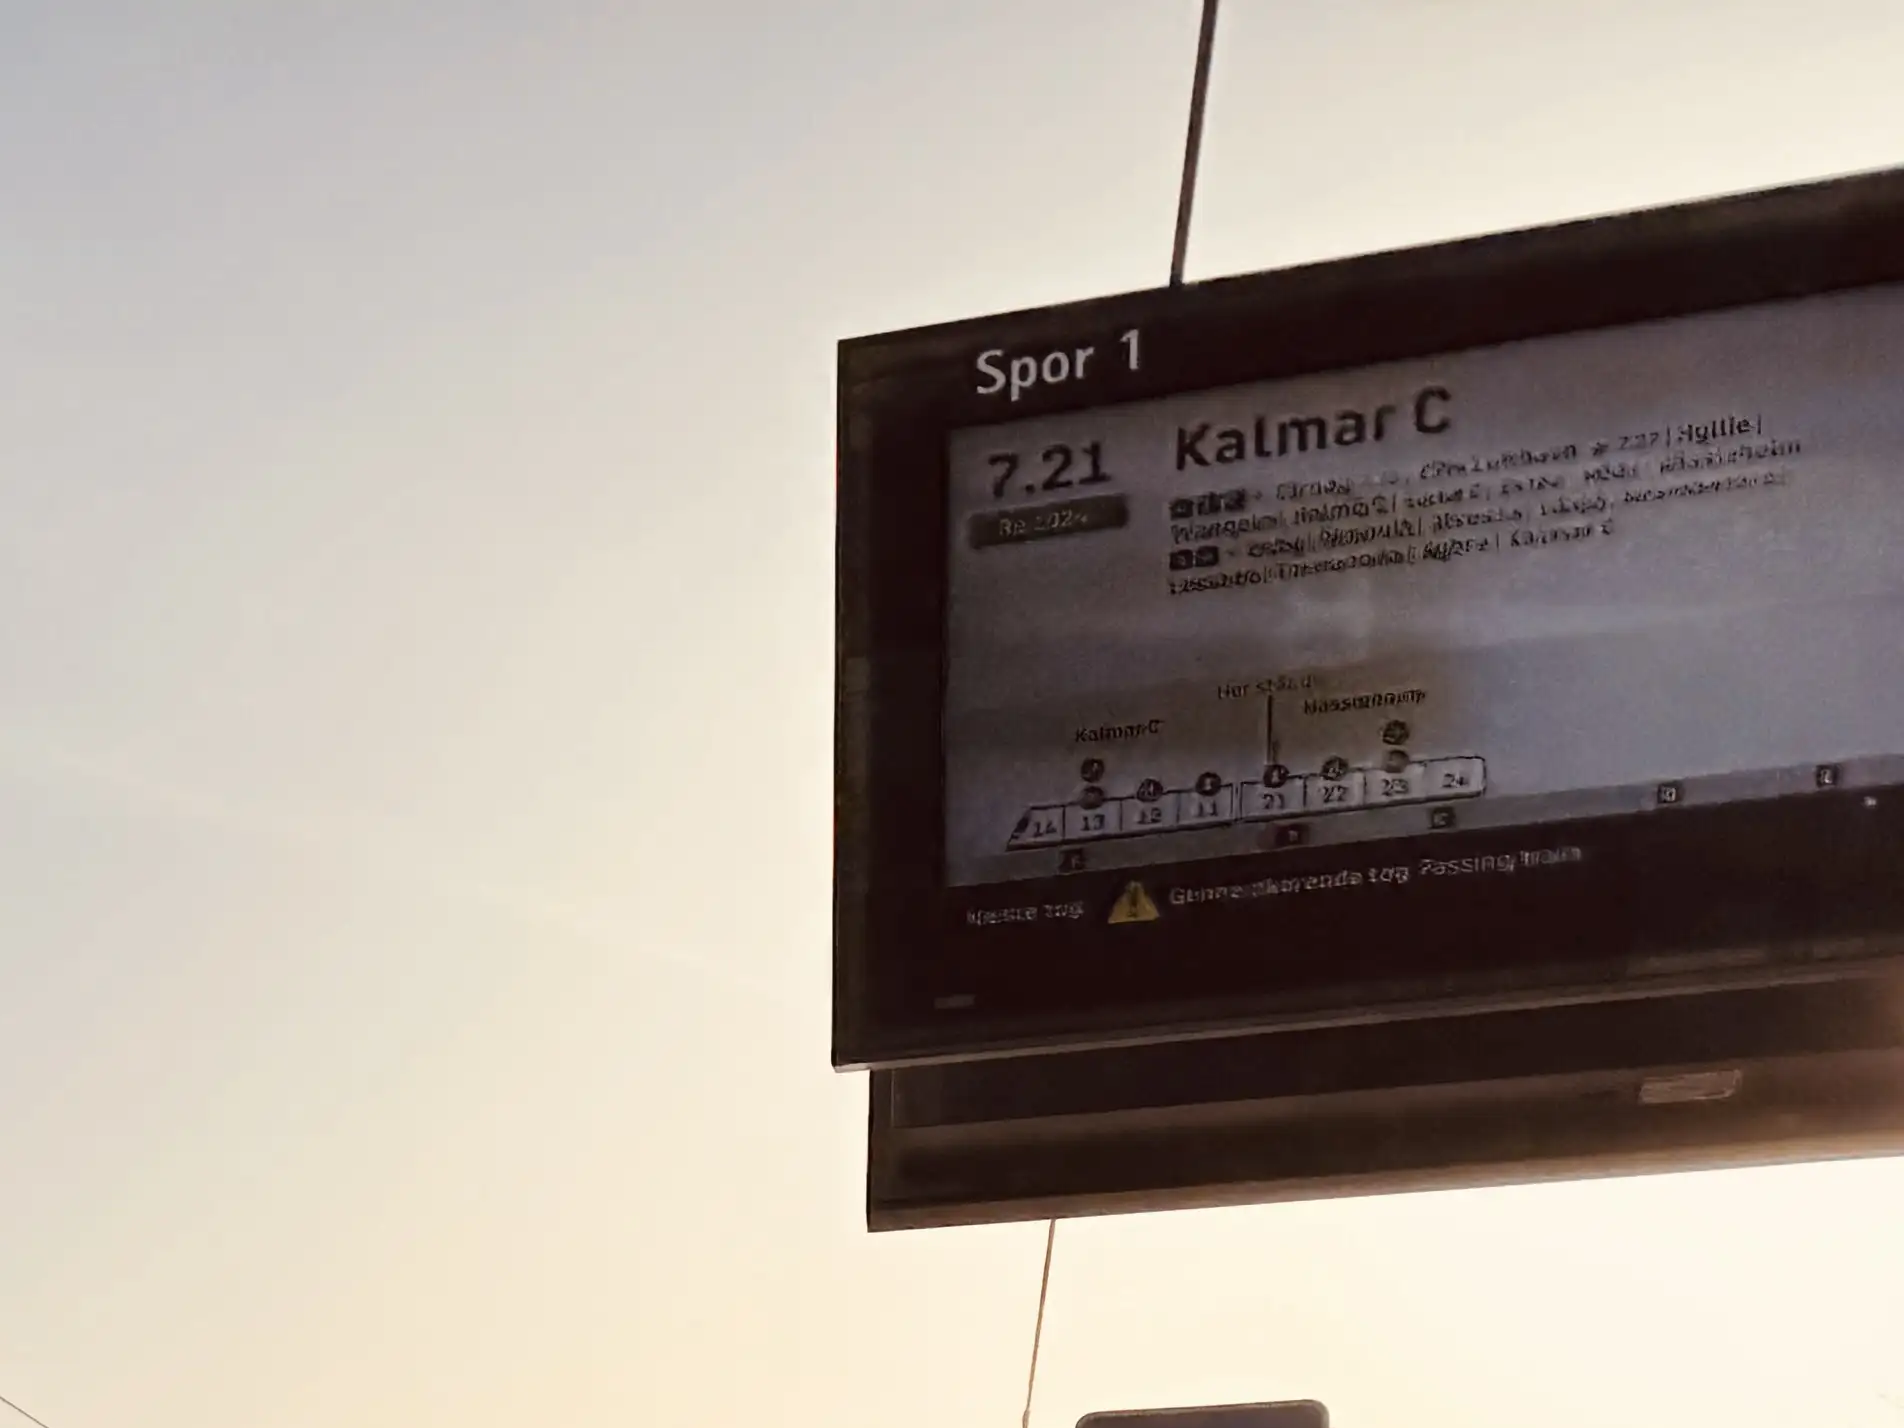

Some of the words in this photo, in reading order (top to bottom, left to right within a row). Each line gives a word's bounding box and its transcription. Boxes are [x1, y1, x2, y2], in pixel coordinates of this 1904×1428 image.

[976, 346, 1095, 401] Spor
[1120, 329, 1141, 369] 1
[1175, 402, 1396, 471] Kalmar
[1413, 385, 1453, 435] C
[988, 440, 1114, 499] 7.21
